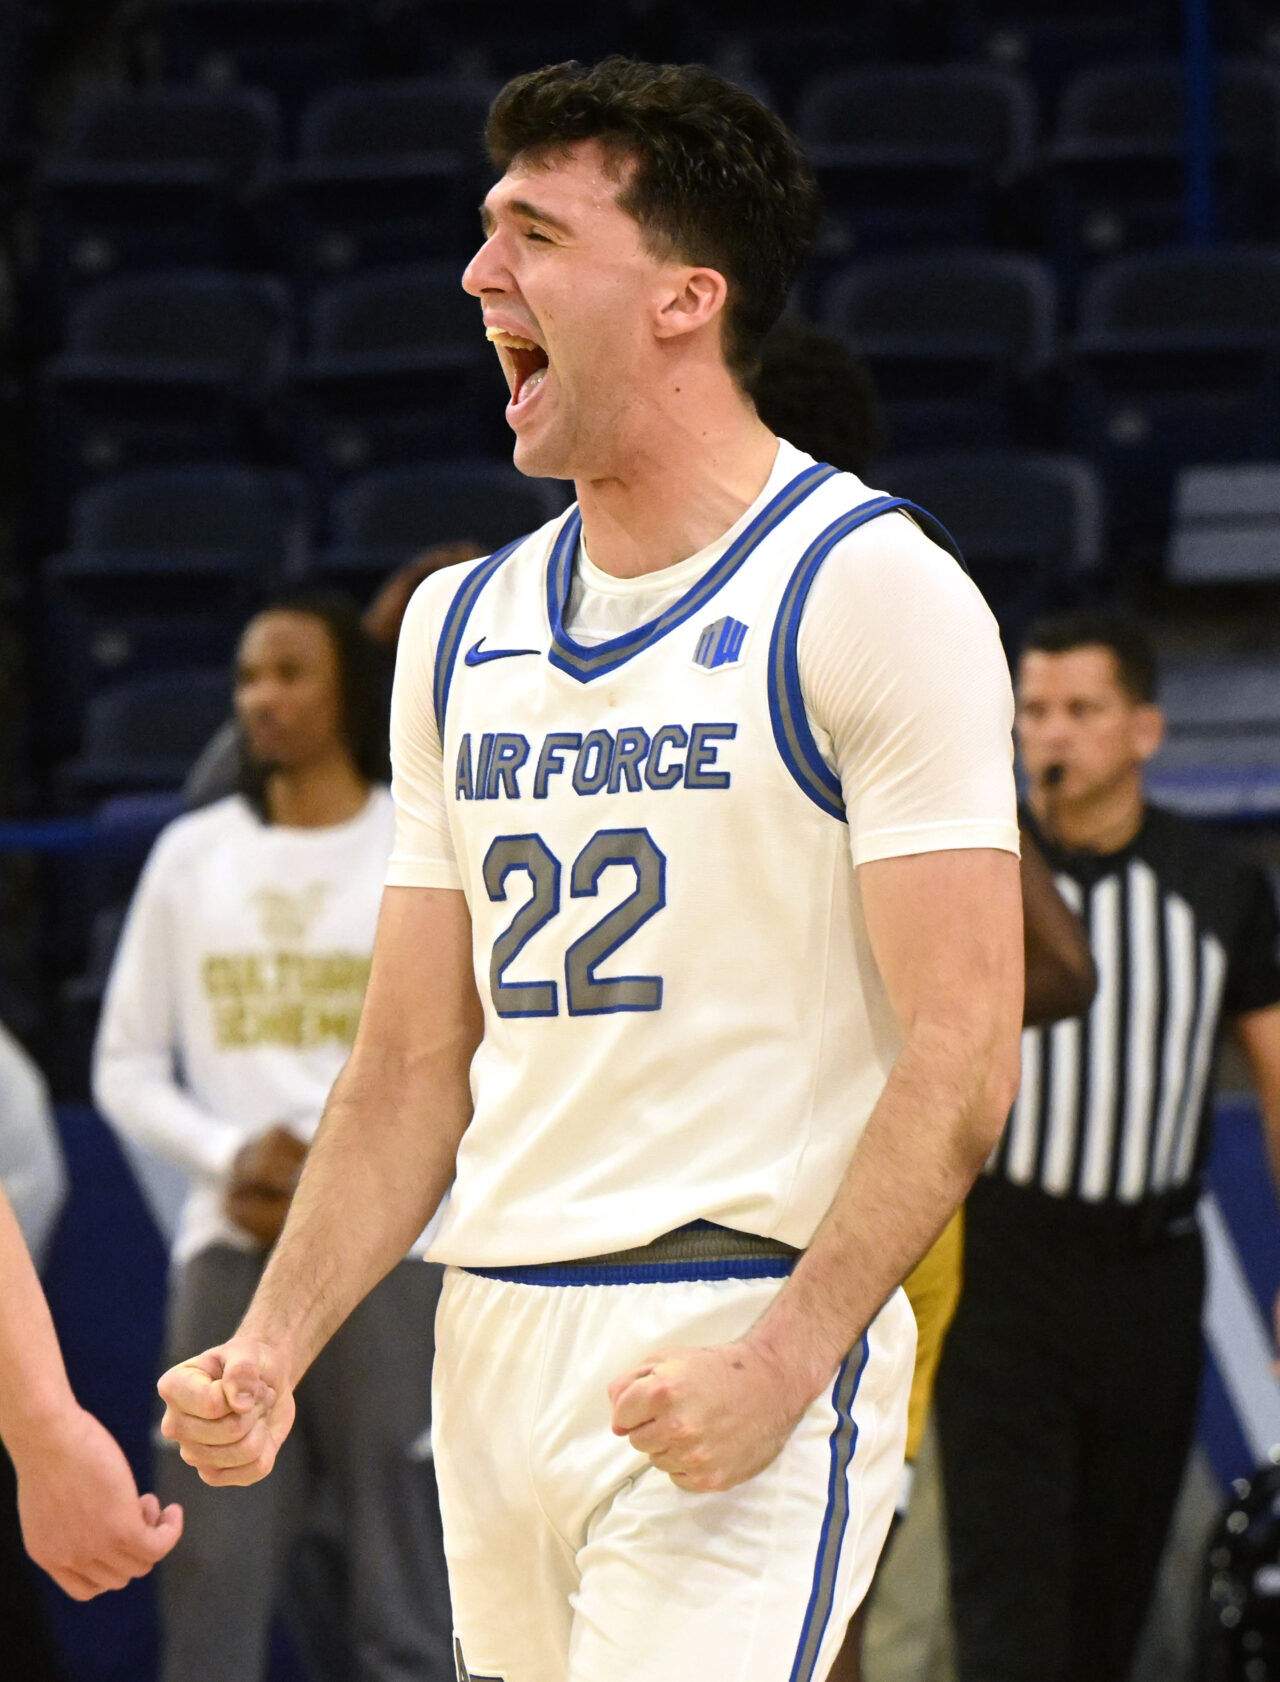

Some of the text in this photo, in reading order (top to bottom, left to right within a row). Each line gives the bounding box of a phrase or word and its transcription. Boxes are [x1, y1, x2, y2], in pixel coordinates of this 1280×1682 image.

[455, 722, 738, 801] AIR FORCE
[482, 827, 667, 1019] 22
